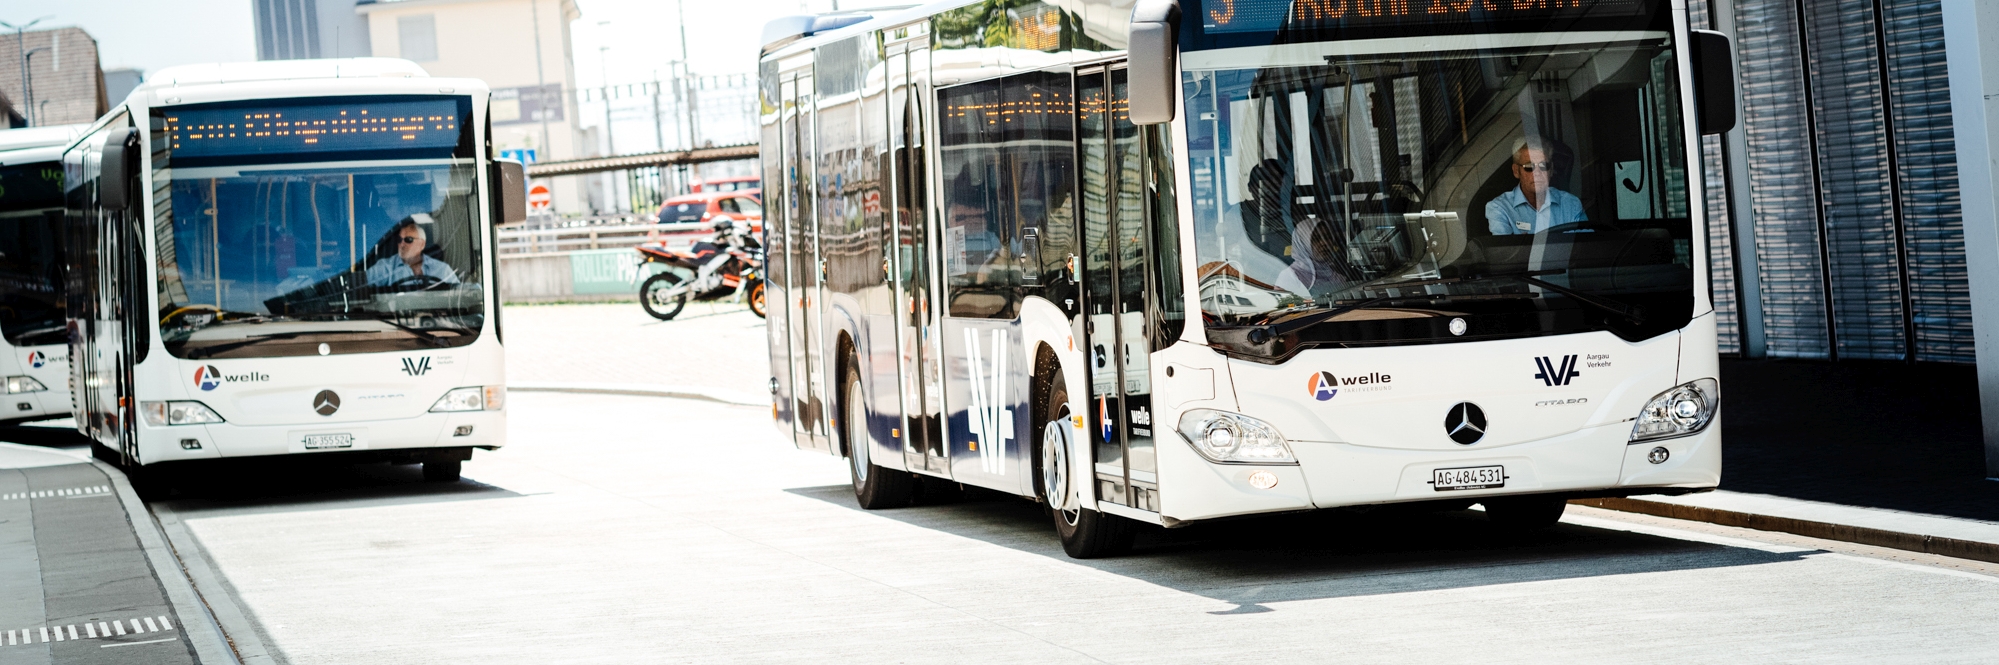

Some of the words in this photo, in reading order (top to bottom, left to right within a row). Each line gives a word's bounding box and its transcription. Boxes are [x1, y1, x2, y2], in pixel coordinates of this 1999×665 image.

[225, 372, 270, 382] welle
[1341, 372, 1392, 385] welle
[1131, 406, 1150, 425] welle
